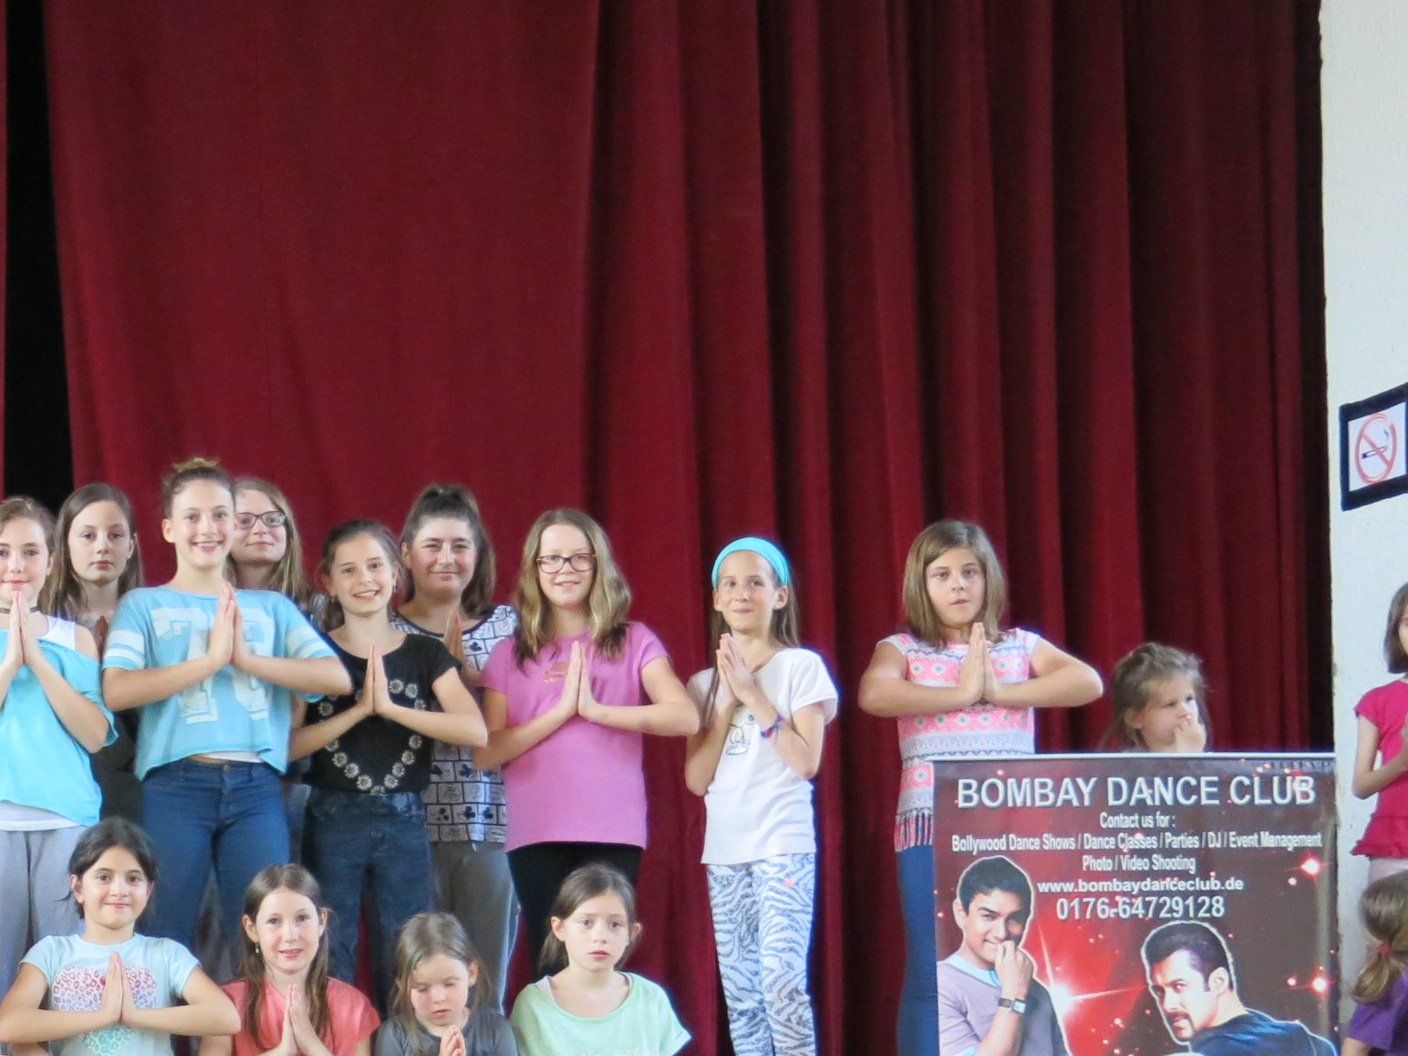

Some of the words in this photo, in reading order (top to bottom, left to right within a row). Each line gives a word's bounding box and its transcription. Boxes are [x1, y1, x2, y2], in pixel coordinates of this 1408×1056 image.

[957, 776, 1098, 809] BOMBAY
[1106, 776, 1220, 807] DANCE
[1229, 775, 1316, 806] CLUB
[1099, 811, 1139, 829] Contact
[1140, 816, 1155, 829] us
[1156, 811, 1170, 829] for
[951, 834, 1007, 855] Bollywood
[1008, 834, 1040, 851] Dance
[1042, 833, 1076, 851] Shows
[1083, 833, 1116, 850] Dance
[1117, 832, 1158, 853] Classes
[1165, 832, 1199, 849] Parties
[1207, 832, 1222, 849] DJ
[1229, 832, 1259, 849] Event
[1259, 831, 1323, 851] Management
[1082, 855, 1113, 872] Photo
[1120, 854, 1150, 871] Video
[1151, 853, 1197, 875] Shooting
[1037, 877, 1245, 896] www.bombaydanceclub.de
[1056, 895, 1226, 921] 0176-64729128
